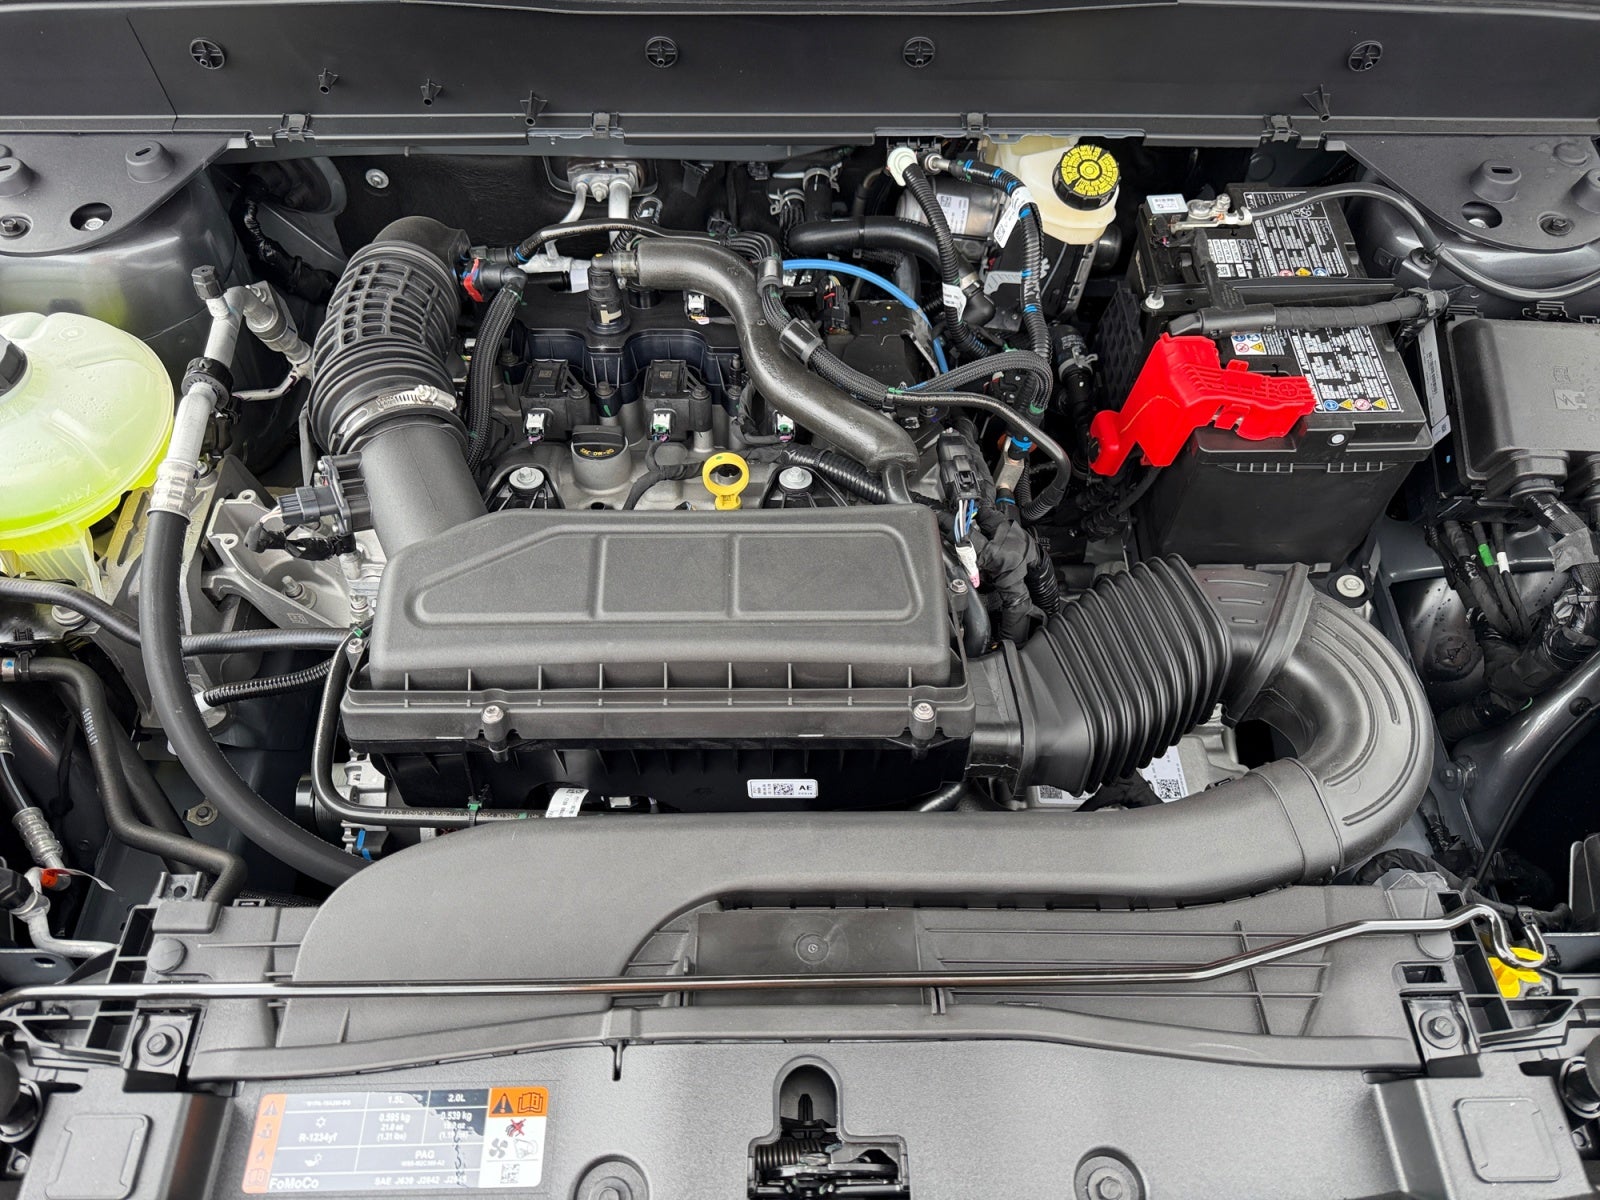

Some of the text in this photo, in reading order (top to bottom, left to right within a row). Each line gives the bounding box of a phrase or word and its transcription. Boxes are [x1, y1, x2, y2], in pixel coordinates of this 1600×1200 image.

[448, 1094, 466, 1102] 2.0L
[401, 1113, 411, 1123] kg
[440, 1111, 472, 1121] 0.539 kg
[298, 1132, 338, 1144] R-1234yf
[415, 1150, 435, 1159] PAG
[269, 1178, 319, 1190] FoMoCo
[374, 1176, 392, 1185] SAE
